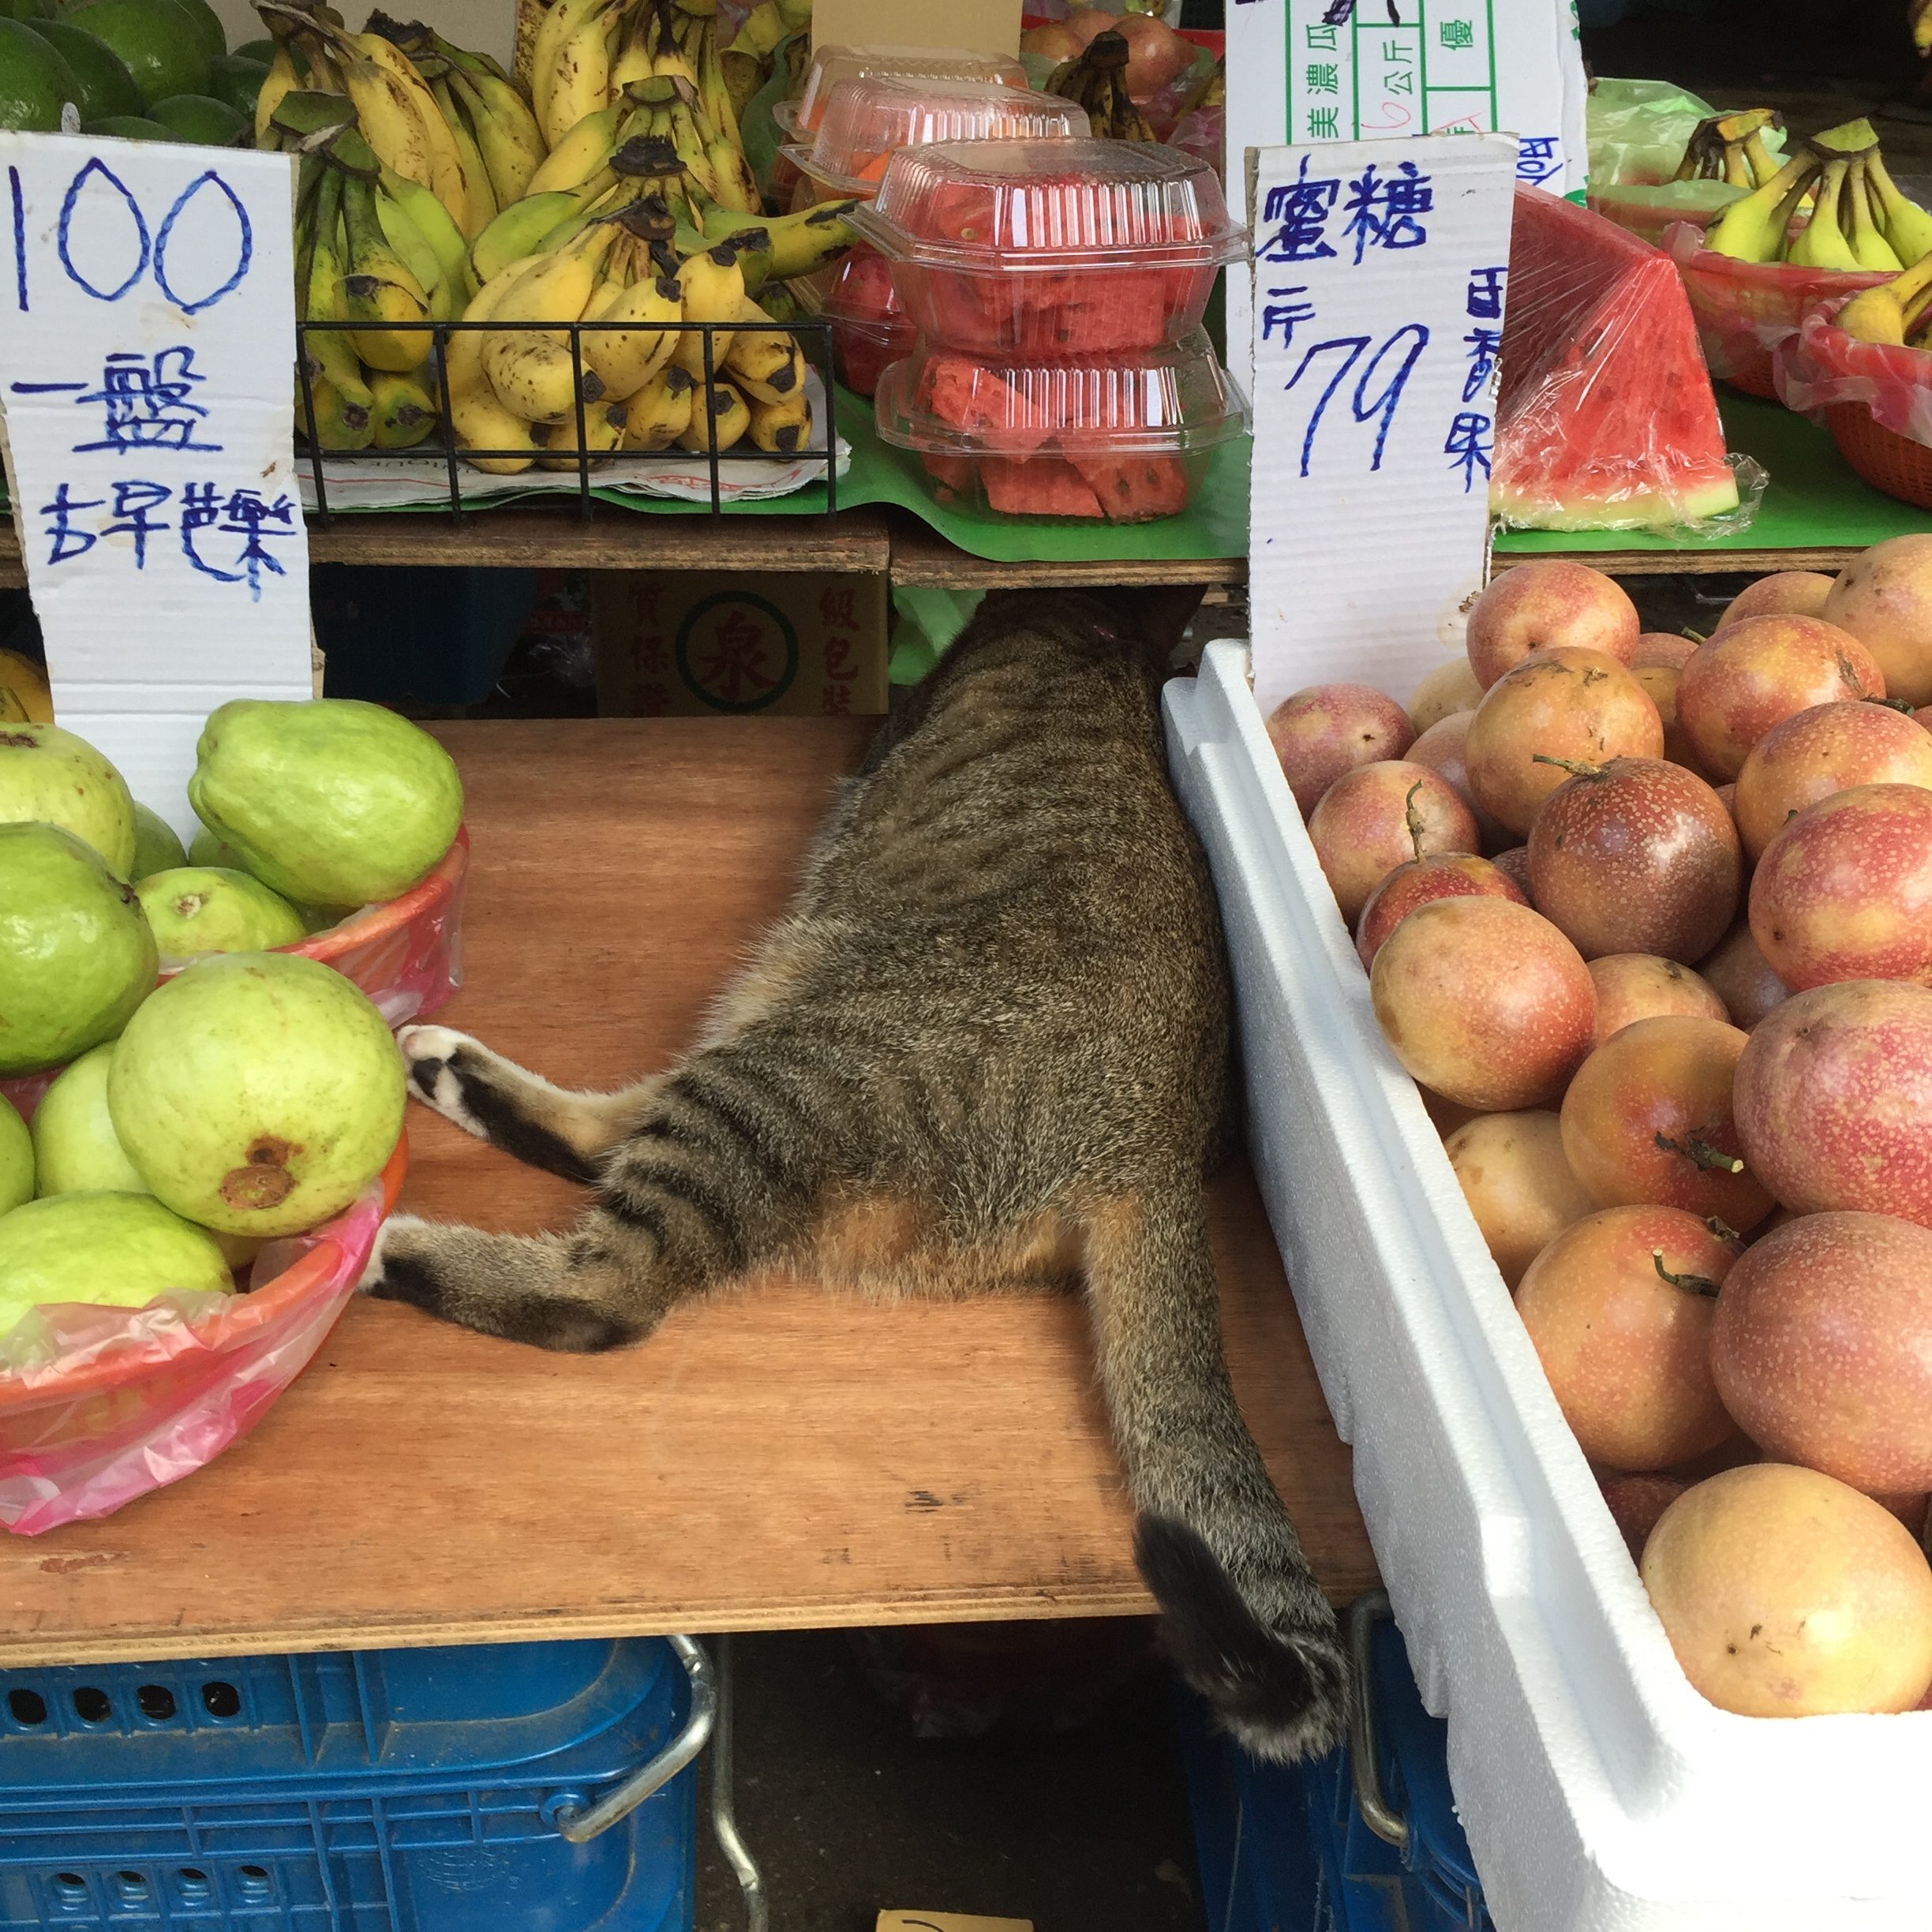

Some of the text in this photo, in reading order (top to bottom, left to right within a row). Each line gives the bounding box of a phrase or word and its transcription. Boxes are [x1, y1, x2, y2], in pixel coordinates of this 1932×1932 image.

[1305, 24, 1339, 139] 美濃瓜
[1382, 40, 1413, 95] 公斤
[1440, 20, 1473, 51] 優
[9, 157, 253, 315] 100
[1255, 153, 1435, 266] 蜜糖
[10, 345, 223, 455] 一盤
[1284, 323, 1430, 478] 79
[698, 610, 777, 702] 泉
